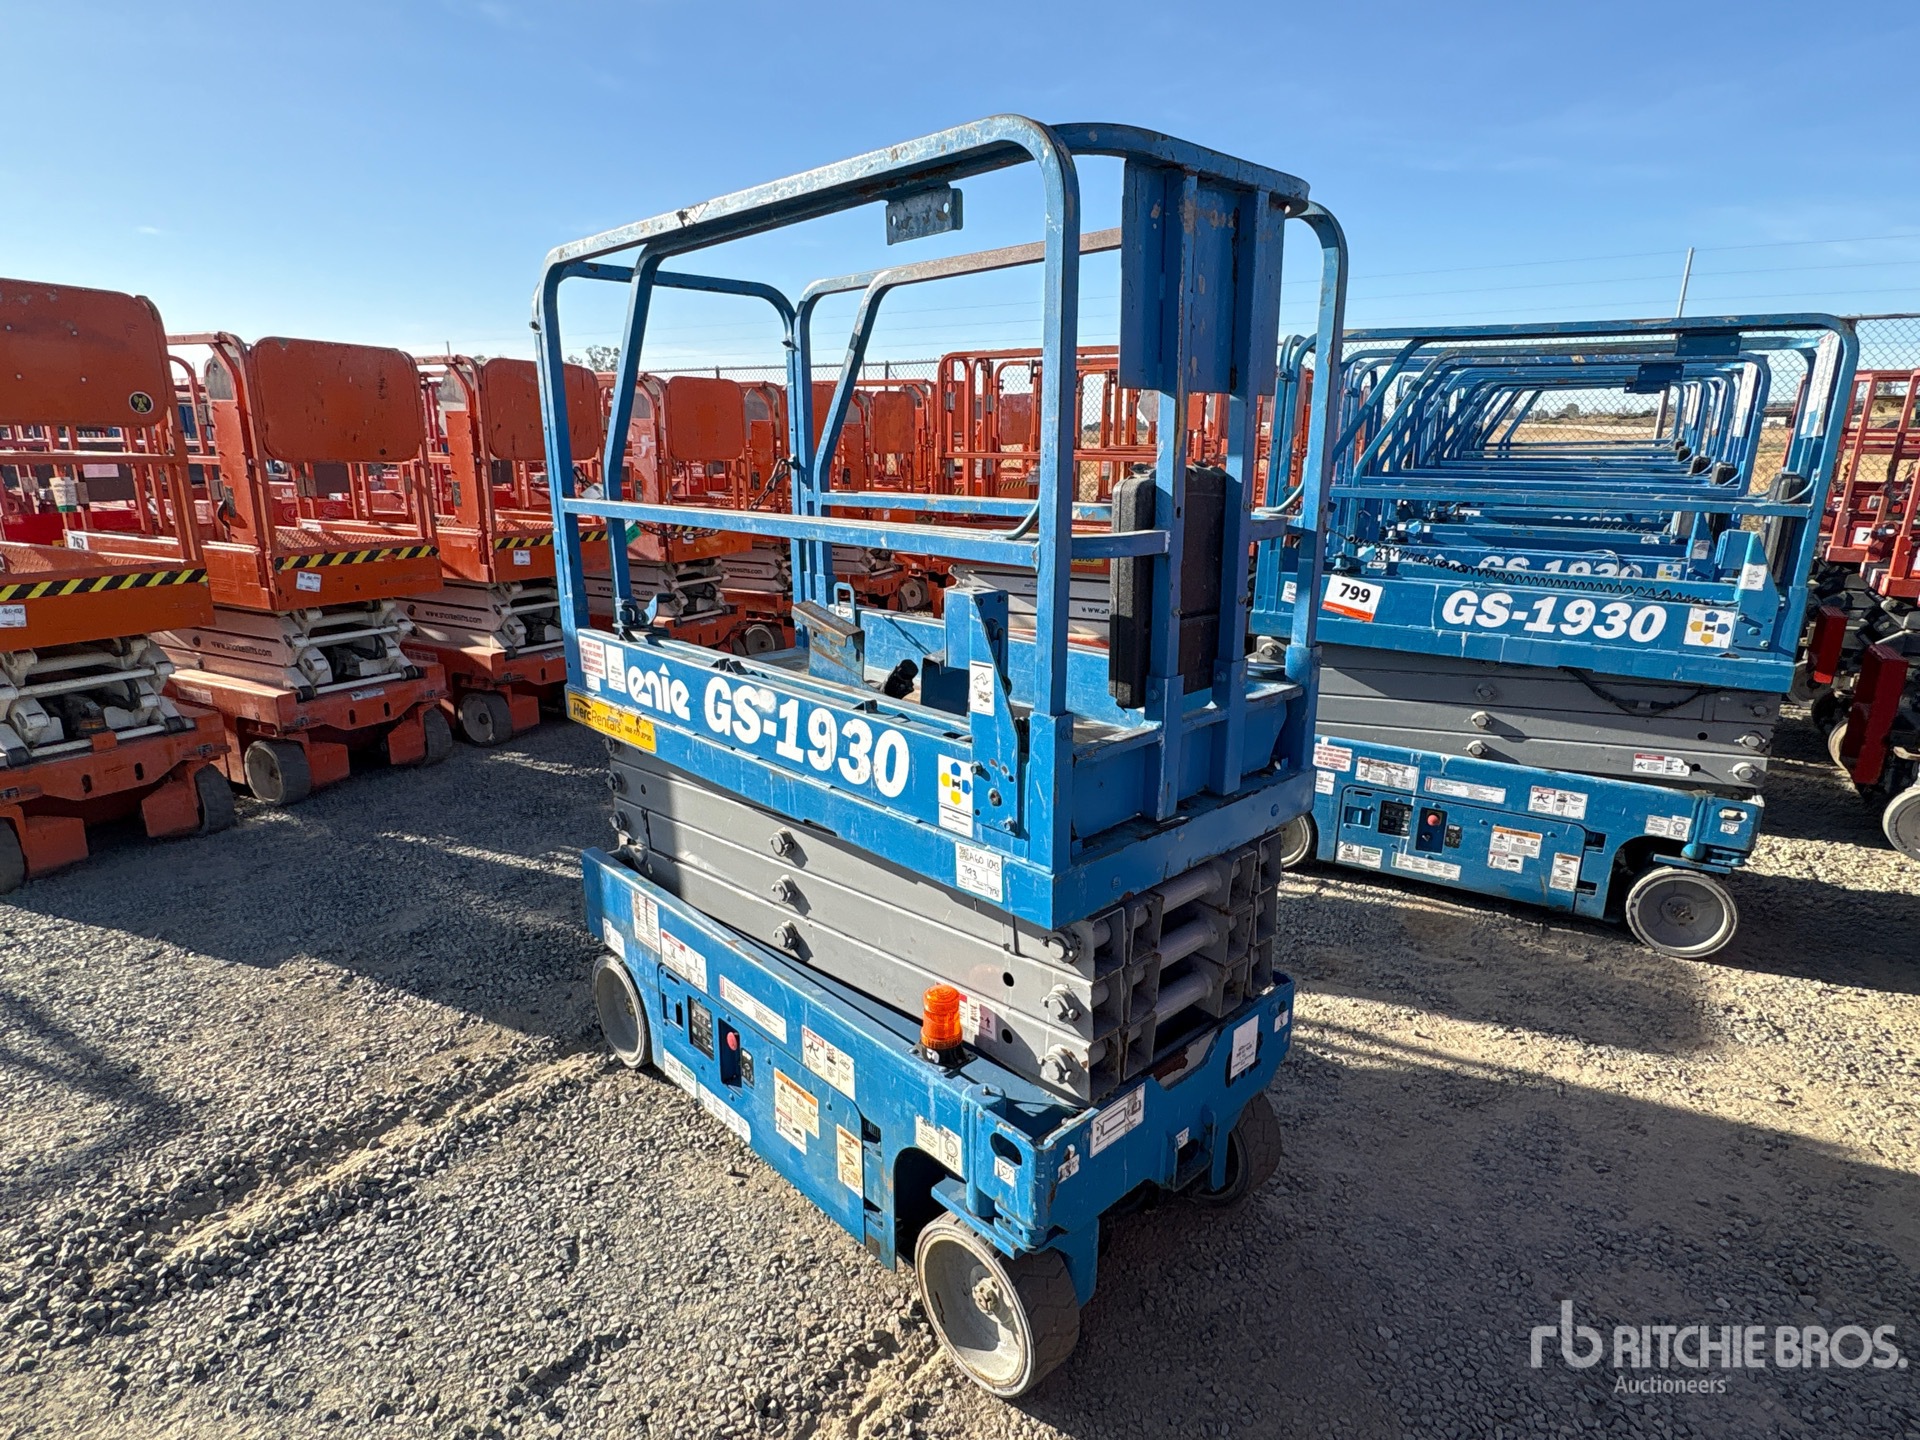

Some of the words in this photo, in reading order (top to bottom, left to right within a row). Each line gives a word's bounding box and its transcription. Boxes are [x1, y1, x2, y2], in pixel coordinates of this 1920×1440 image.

[1339, 582, 1371, 603] 799
[1441, 589, 1667, 643] GS-1930
[627, 662, 691, 721] enie
[704, 677, 909, 798] GS-1930
